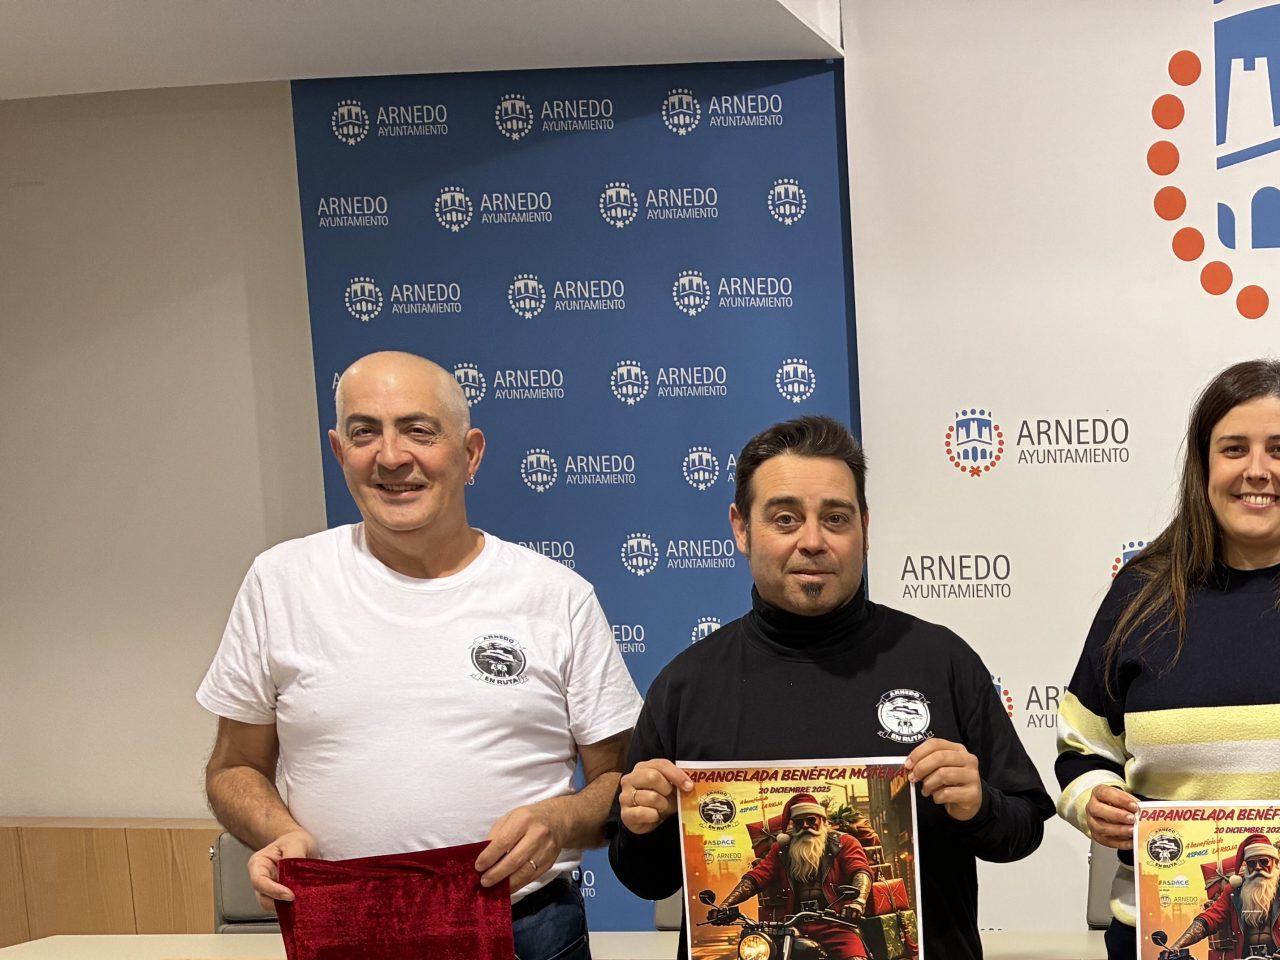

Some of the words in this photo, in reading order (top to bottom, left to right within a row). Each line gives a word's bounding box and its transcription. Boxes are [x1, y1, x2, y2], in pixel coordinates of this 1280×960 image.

[541, 99, 612, 118] ARNEDO
[709, 95, 782, 114] ARNEDO
[377, 105, 447, 124] ARNEDO
[710, 115, 782, 126] AYUNTAMIENTO
[378, 124, 448, 136] AYUNTAMIENTO
[543, 119, 614, 131] AYUNTAMIENTO
[481, 192, 551, 211] ARNEDO
[646, 188, 717, 207] ARNEDO
[318, 196, 387, 215] ARNEDO
[482, 212, 552, 223] AYUNTAMIENTO
[647, 208, 718, 219] AYUNTAMIENTO
[320, 216, 388, 226] AYUNTAMIENTO
[391, 283, 460, 301] ARNEDO
[554, 280, 624, 298] ARNEDO
[718, 278, 791, 295] ARNEDO
[392, 303, 461, 313] AYUNTAMIENTO
[555, 299, 625, 310] AYUNTAMIENTO
[719, 297, 792, 307] AYUNTAMIENTO
[494, 369, 563, 387] ARNEDO
[657, 367, 726, 385] ARNEDO
[495, 388, 564, 399] AYUNTAMIENTO
[658, 386, 726, 396] AYUNTAMIENTO
[1017, 418, 1128, 445] ARNEDO
[1018, 448, 1129, 464] AYUNTAMIENTO
[565, 455, 634, 472] ARNEDO
[567, 474, 635, 484] AYUNTAMIENTO
[666, 540, 735, 557] ARNEDO
[668, 558, 735, 568] AYUNTAMIENTO
[901, 555, 1010, 580] ARNEDO
[903, 584, 1011, 598] AYUNTAMIENTO
[483, 634, 515, 644] ARNEDO
[612, 625, 645, 642] EDO
[484, 676, 495, 684] EN
[889, 689, 920, 698] ARNEDO
[903, 734, 923, 742] RUTA
[686, 770, 778, 783] APANOELADA
[781, 766, 847, 781] BENÉFICA
[770, 786, 811, 794] DICIEMBRE
[1139, 808, 1235, 822] PAPANOELADA
[1225, 826, 1265, 834] DICIEMBRE
